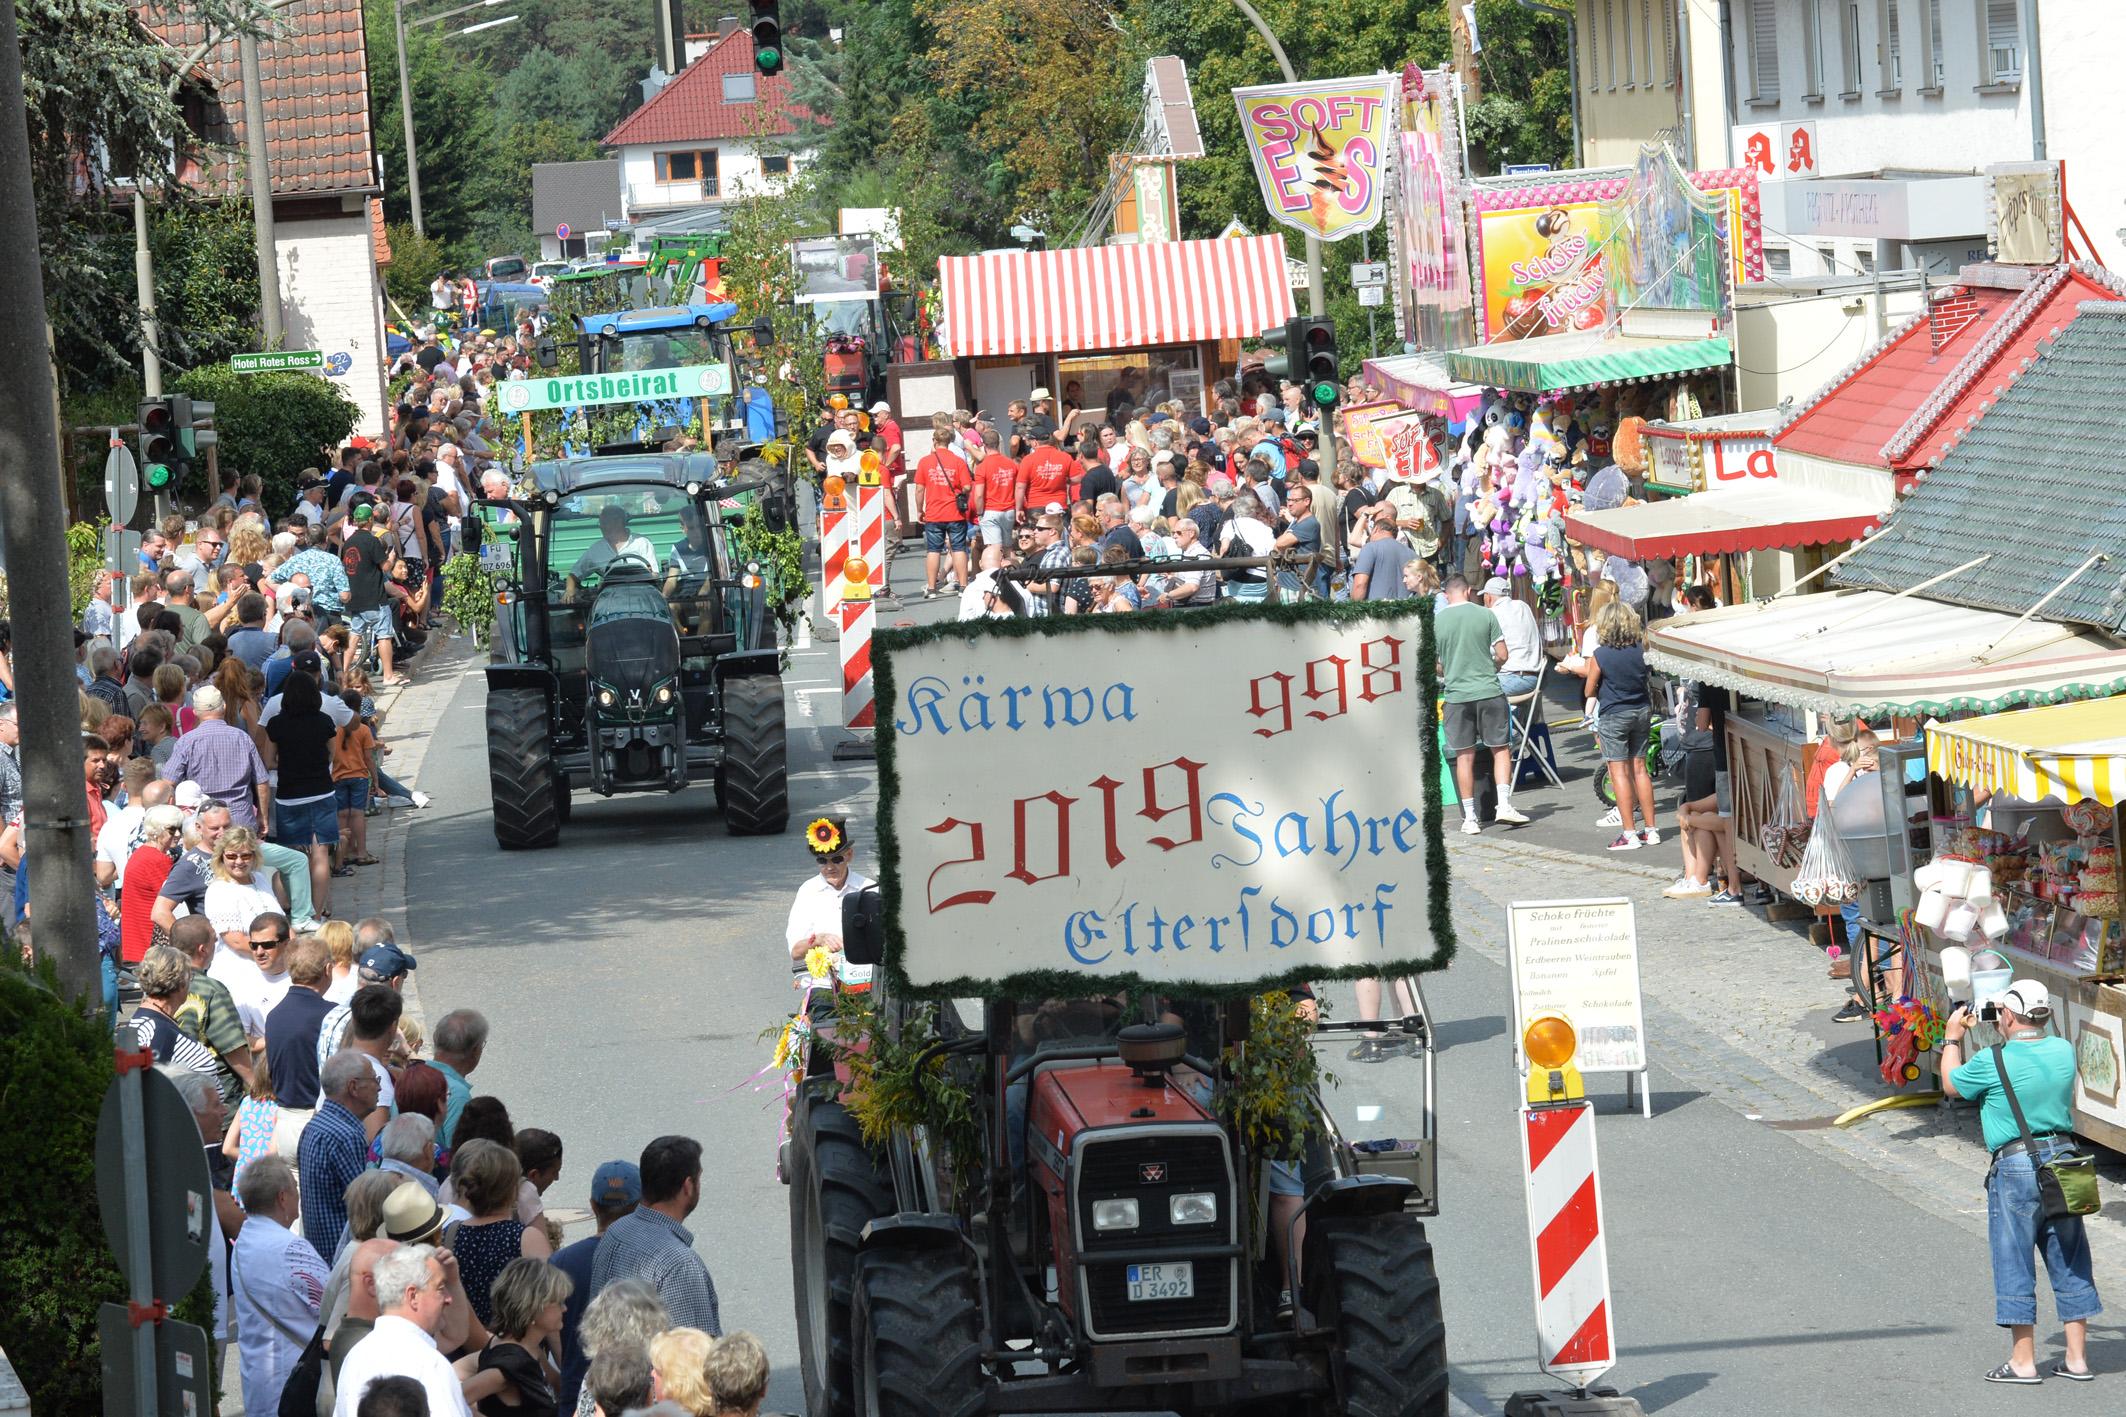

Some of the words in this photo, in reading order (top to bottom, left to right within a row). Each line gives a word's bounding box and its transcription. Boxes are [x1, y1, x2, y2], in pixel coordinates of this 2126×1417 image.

[1251, 96, 1383, 143] SOFT
[233, 358, 257, 369] Hotel
[260, 357, 285, 368] Rotes
[287, 355, 310, 366] Ross
[334, 353, 348, 365] 22
[547, 372, 678, 403] Ortsbeirat
[1395, 427, 1446, 477] EIS
[495, 561, 511, 569] 696
[896, 675, 1139, 736] Kärwa
[1244, 634, 1406, 739] 998
[925, 756, 1208, 915] 2019
[1206, 789, 1418, 872] Jahre
[1529, 911, 1571, 922] Schoko
[1573, 908, 1616, 919] früchte
[1525, 956, 1572, 965] Erdbeeren
[1582, 999, 1633, 1009] Schokolade
[1141, 1266, 1163, 1281] ER
[1149, 1281, 1188, 1298] 3492
